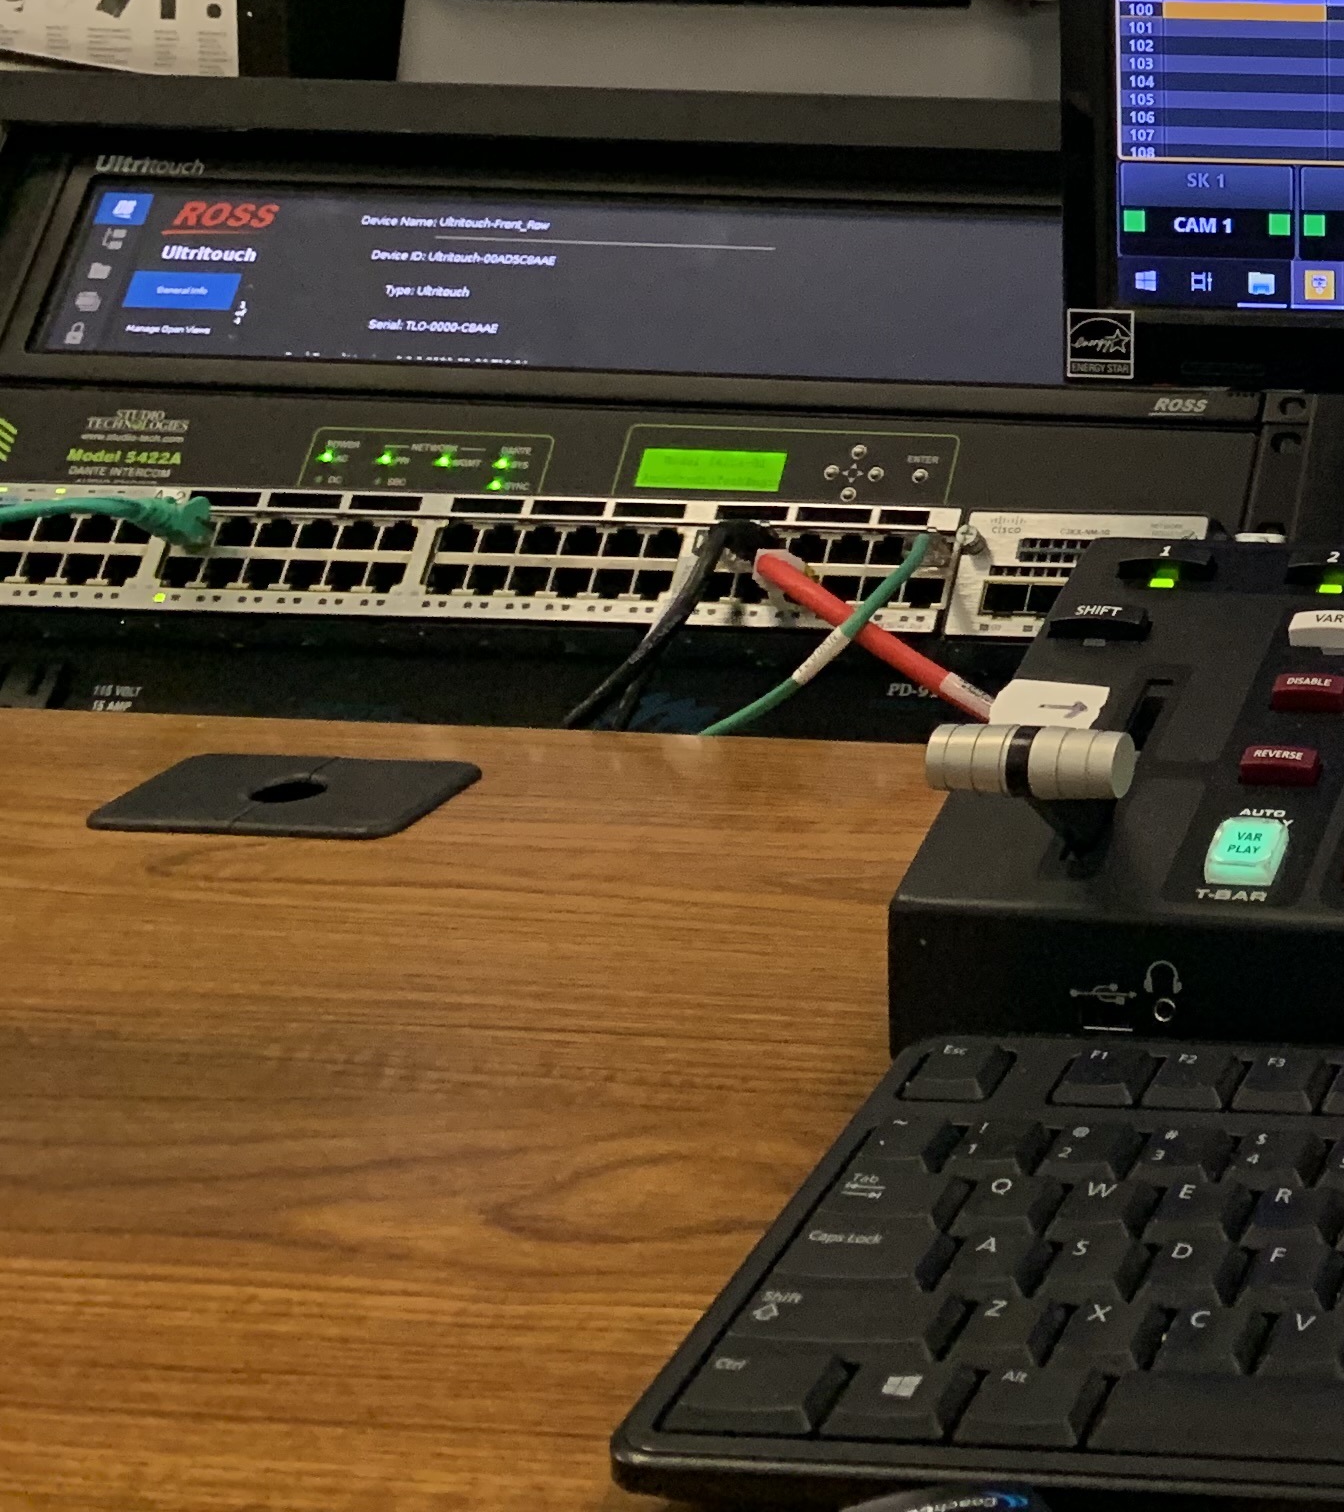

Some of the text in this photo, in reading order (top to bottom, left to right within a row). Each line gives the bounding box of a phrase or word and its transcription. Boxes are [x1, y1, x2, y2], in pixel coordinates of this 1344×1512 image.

[1128, 3, 1154, 17] 100
[1128, 21, 1152, 35] 101
[1128, 39, 1154, 53] 102
[1129, 57, 1154, 70] 103
[96, 155, 205, 175] Ultritouch
[173, 201, 280, 228] ROSS
[361, 215, 398, 226] Device
[1174, 217, 1233, 234] CAM 1
[161, 245, 257, 262] Ultritouch
[1071, 362, 1130, 376] ENERGY STAR
[1153, 397, 1208, 413] ROSS
[67, 449, 121, 462] Model
[1075, 604, 1123, 617] SHIFT
[1315, 614, 1344, 624] VAR
[1253, 749, 1304, 761] REVERSE
[1237, 831, 1263, 842] VAR
[1227, 844, 1261, 855] PLAY
[1196, 890, 1268, 902] T-BAR
[943, 1044, 968, 1056] Esc
